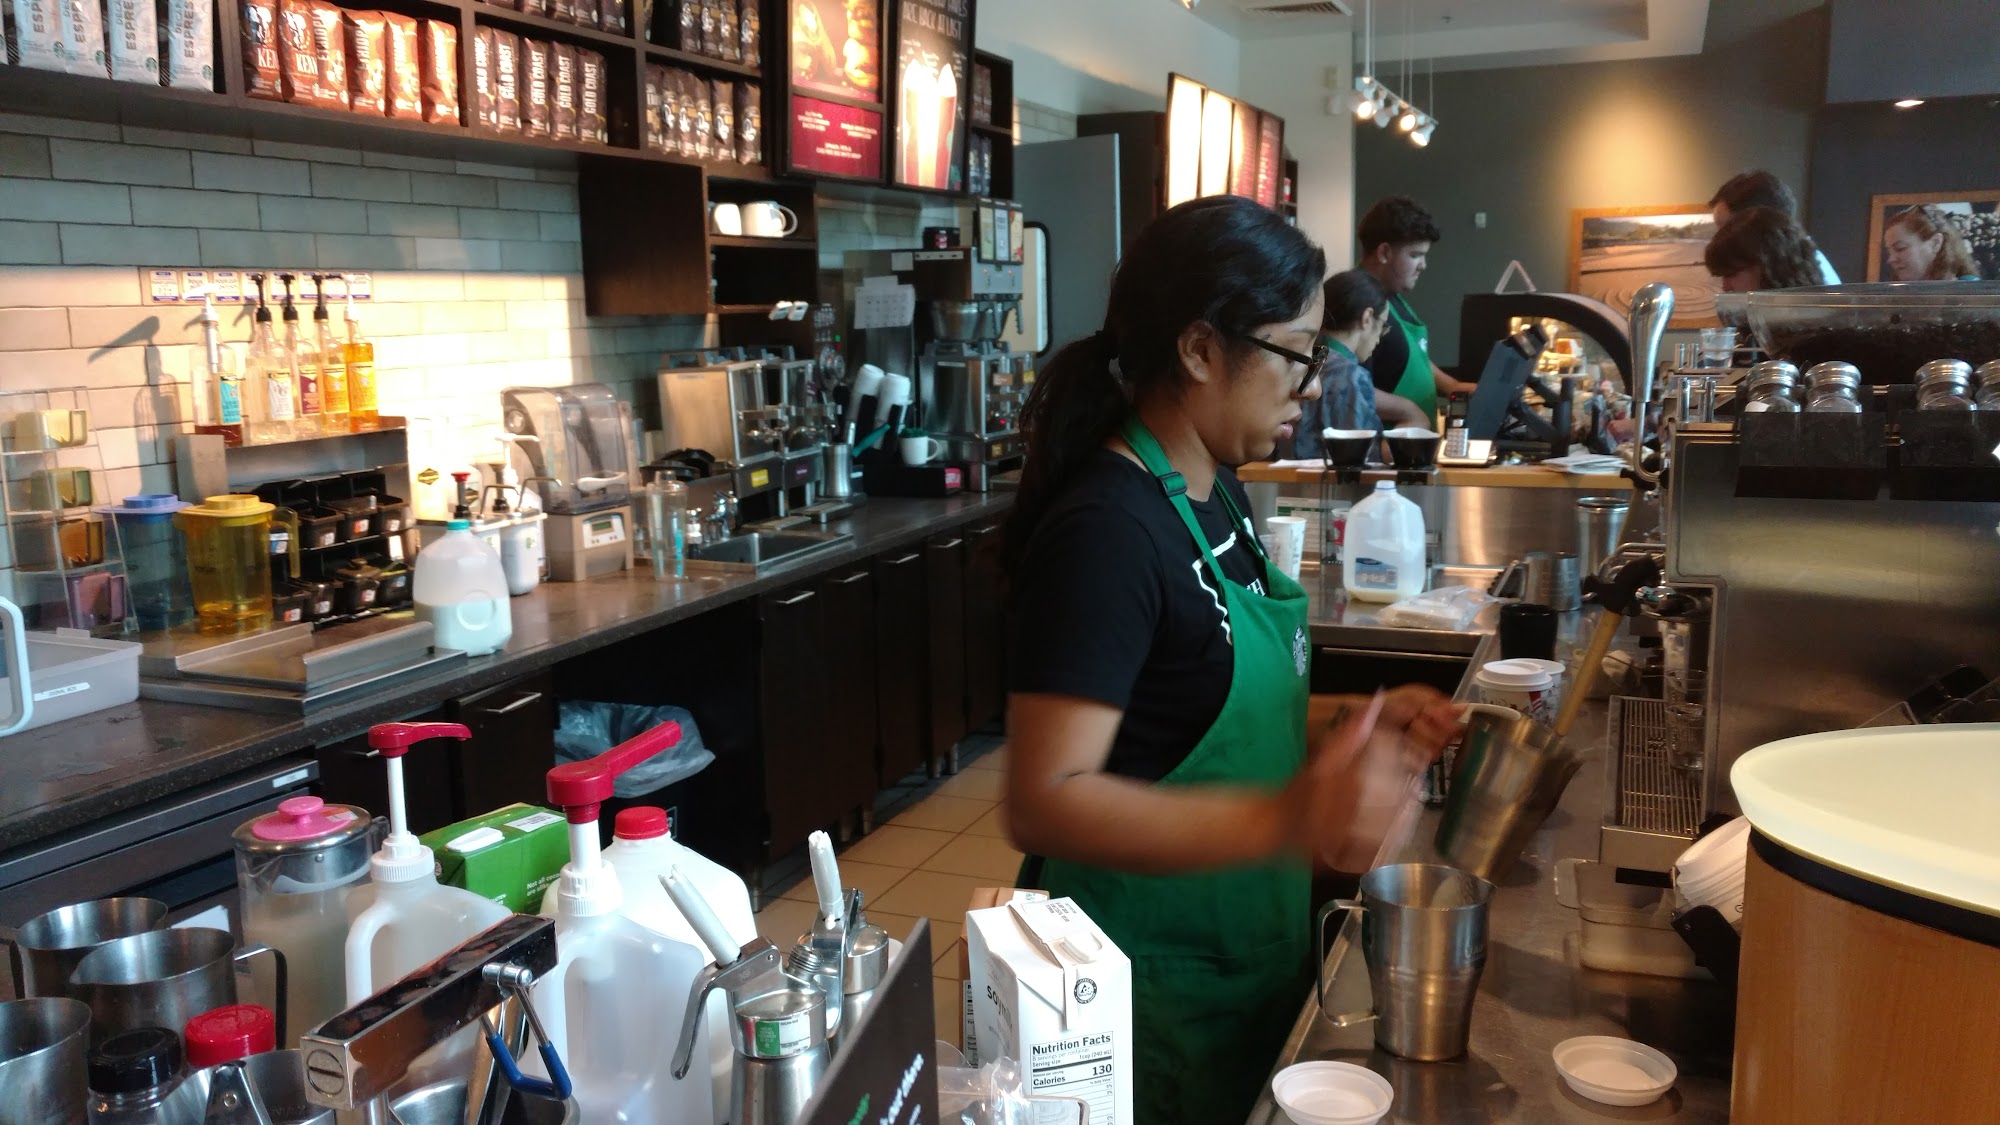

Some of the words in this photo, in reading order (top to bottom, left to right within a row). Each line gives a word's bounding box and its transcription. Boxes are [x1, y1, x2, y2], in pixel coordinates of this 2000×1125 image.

[531, 51, 545, 79] COAST
[558, 55, 571, 83] COAST
[584, 62, 597, 89] COAST
[531, 80, 546, 105] GOLD
[558, 85, 572, 109] GOLD
[584, 91, 597, 114] GOLD
[1032, 1040, 1080, 1055] Nutrition
[1082, 1034, 1111, 1047] Facts
[1032, 1059, 1051, 1067] Serving
[1033, 1075, 1066, 1086] Calories
[1092, 1063, 1112, 1076] 130
